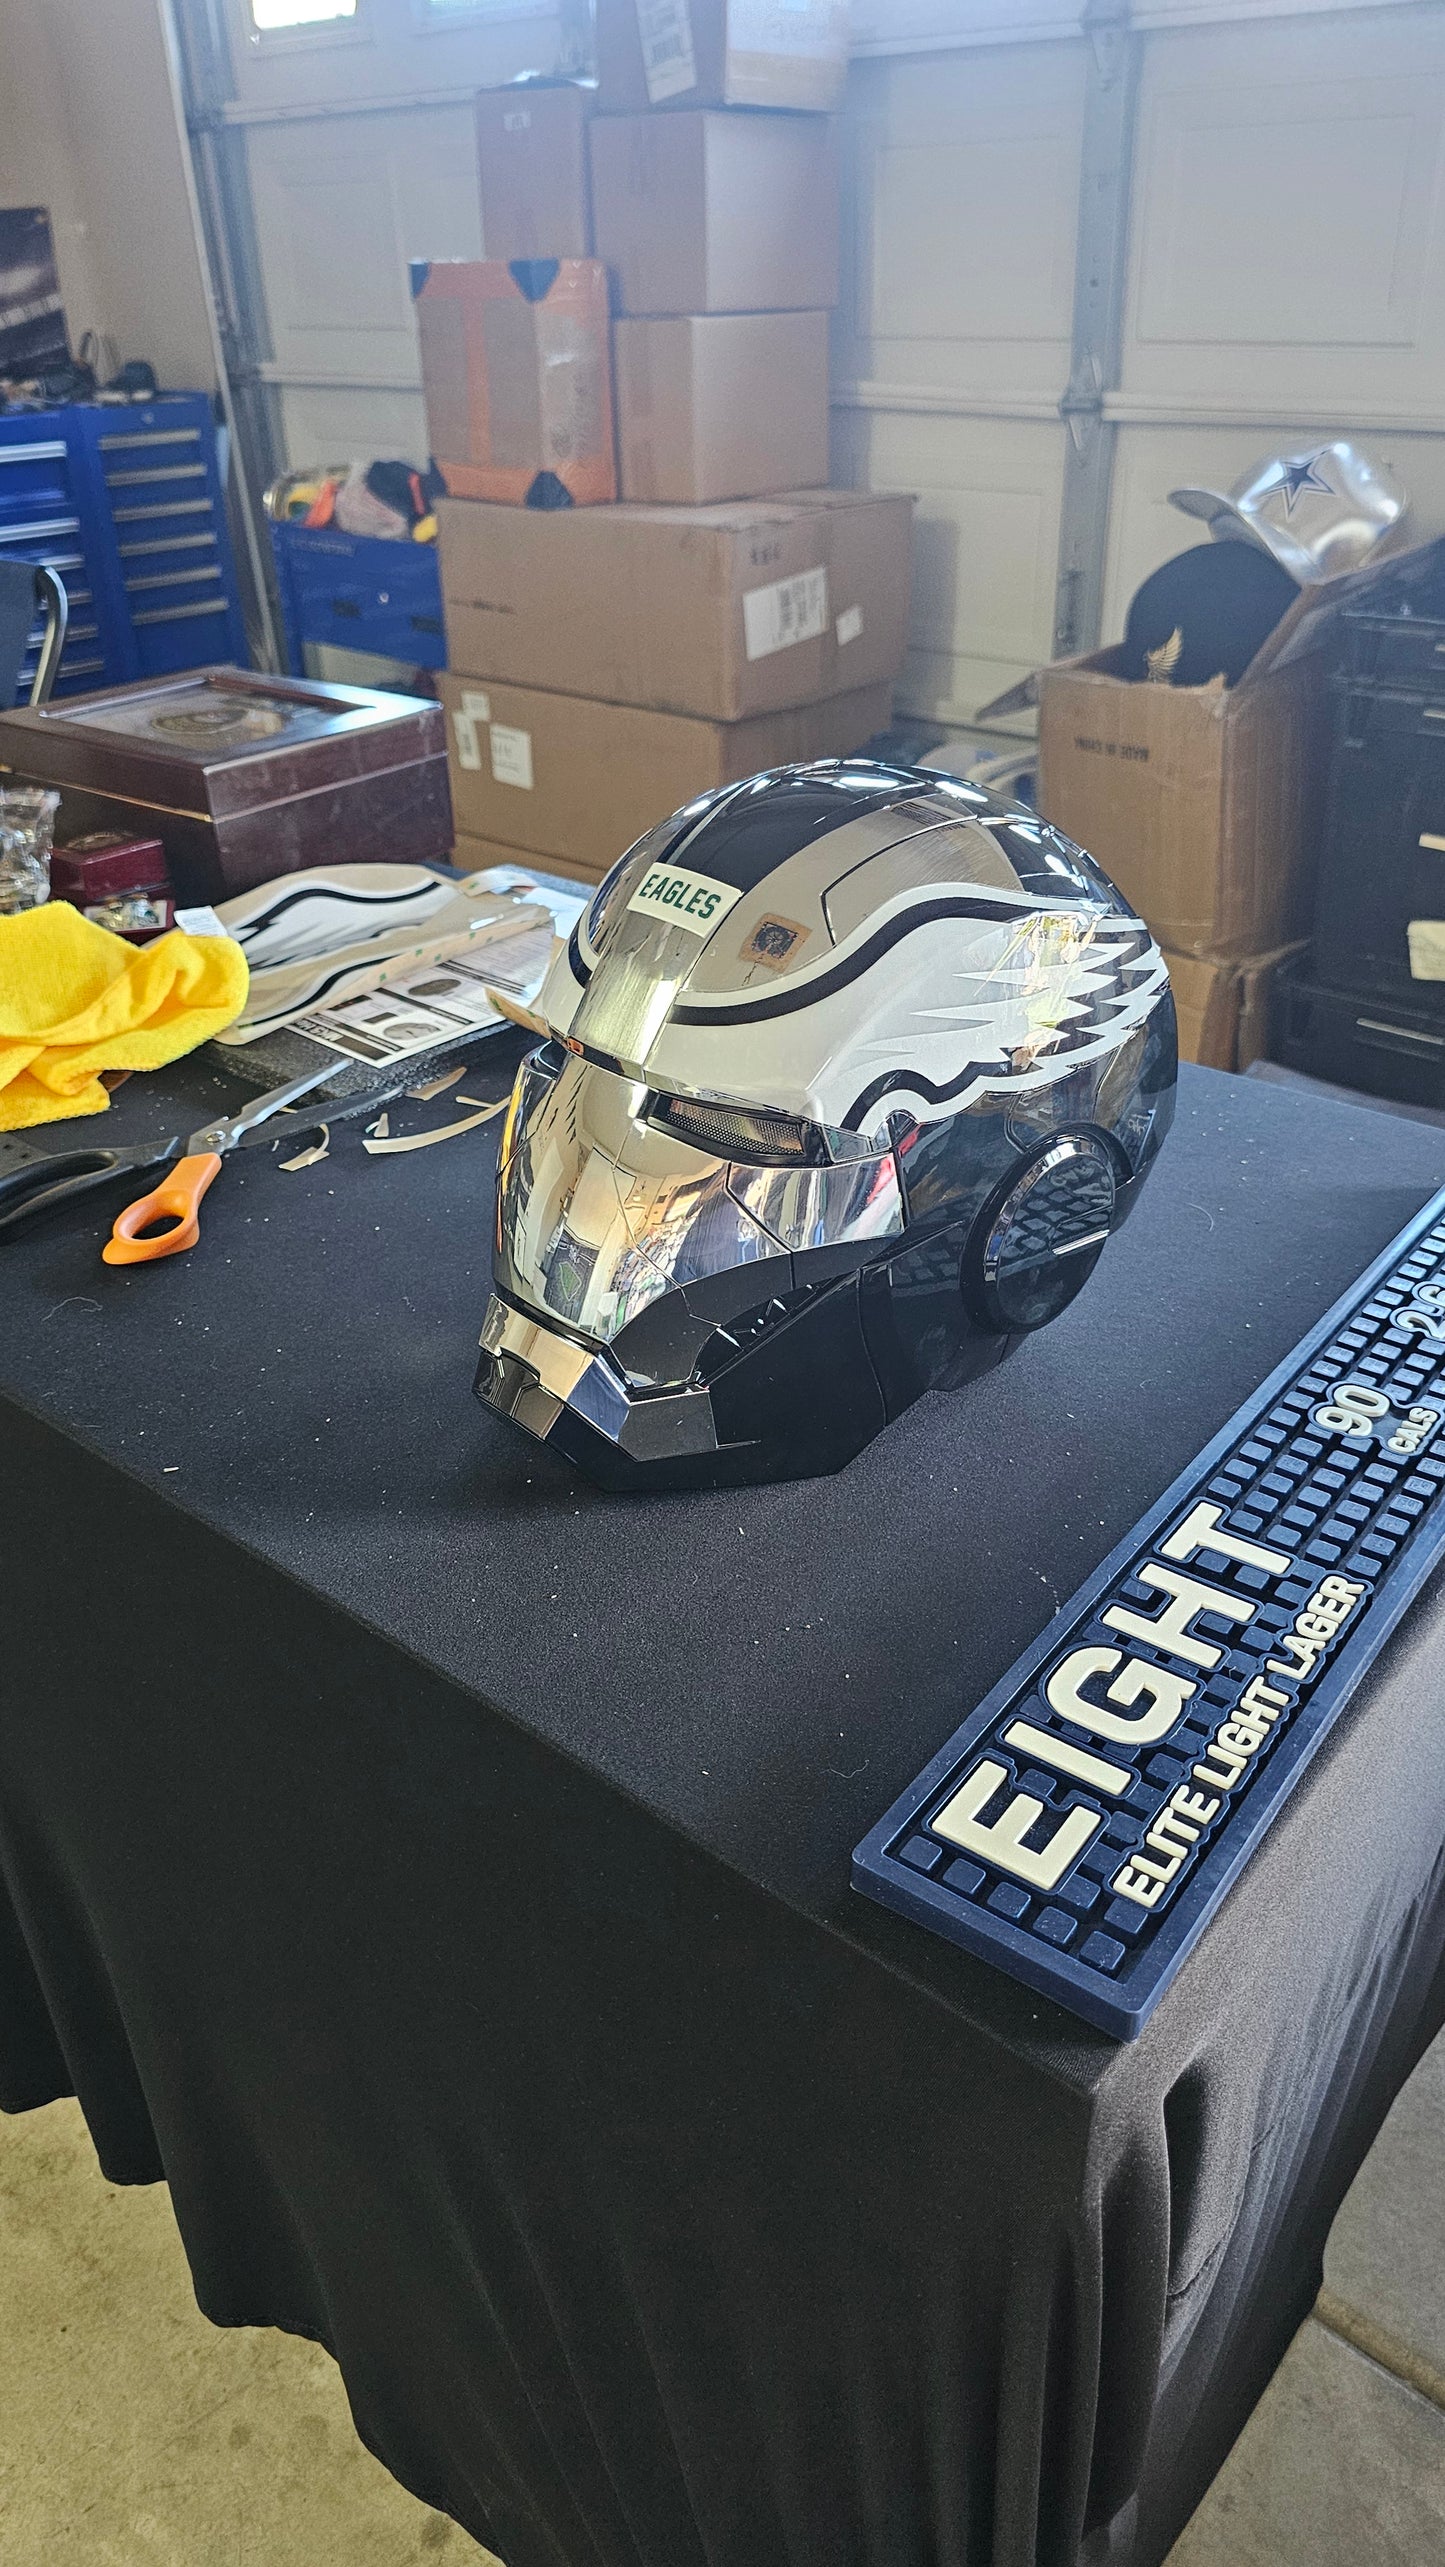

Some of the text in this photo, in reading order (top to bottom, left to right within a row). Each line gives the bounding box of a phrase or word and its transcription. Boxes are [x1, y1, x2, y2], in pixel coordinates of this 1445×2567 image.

[638, 874, 722, 919] EAGLES
[1315, 1385, 1390, 1437] 90
[1387, 1407, 1439, 1453] CALS
[932, 1502, 1291, 1890] EIGHT
[1113, 1575, 1365, 1907] ELITE LIGHT LAGER
